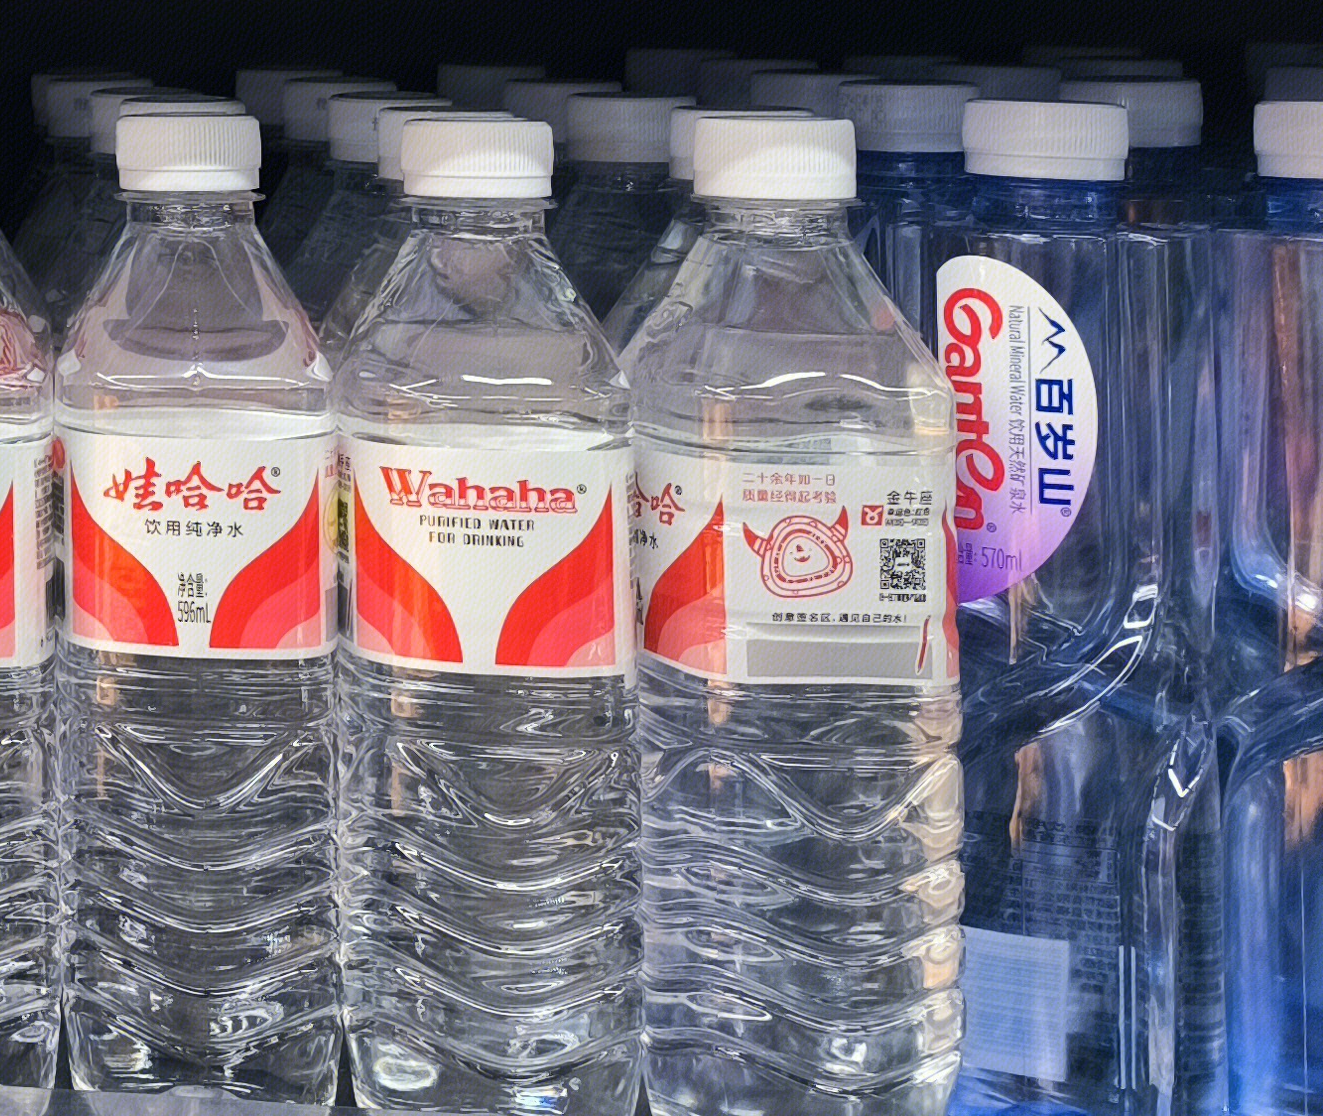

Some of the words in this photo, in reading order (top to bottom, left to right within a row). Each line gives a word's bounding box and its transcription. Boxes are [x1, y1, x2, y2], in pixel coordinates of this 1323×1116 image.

[1008, 304, 1024, 341] Natural
[1008, 341, 1024, 384] Mineral
[1009, 386, 1023, 416] Water
[1035, 378, 1076, 507] 百岁山
[103, 456, 281, 512] 娃哈哈
[379, 466, 578, 515] Wahaha
[742, 473, 836, 486] 二十余年如一日
[742, 489, 837, 504] 质量经得起考验
[886, 490, 934, 505] 金牛座
[144, 519, 244, 538] 饮用纯净水
[419, 515, 483, 533] PURIFIED
[488, 518, 536, 533] WATER
[429, 531, 456, 547] FOR
[463, 533, 525, 549] DRINKING
[981, 545, 1023, 571] 570ml
